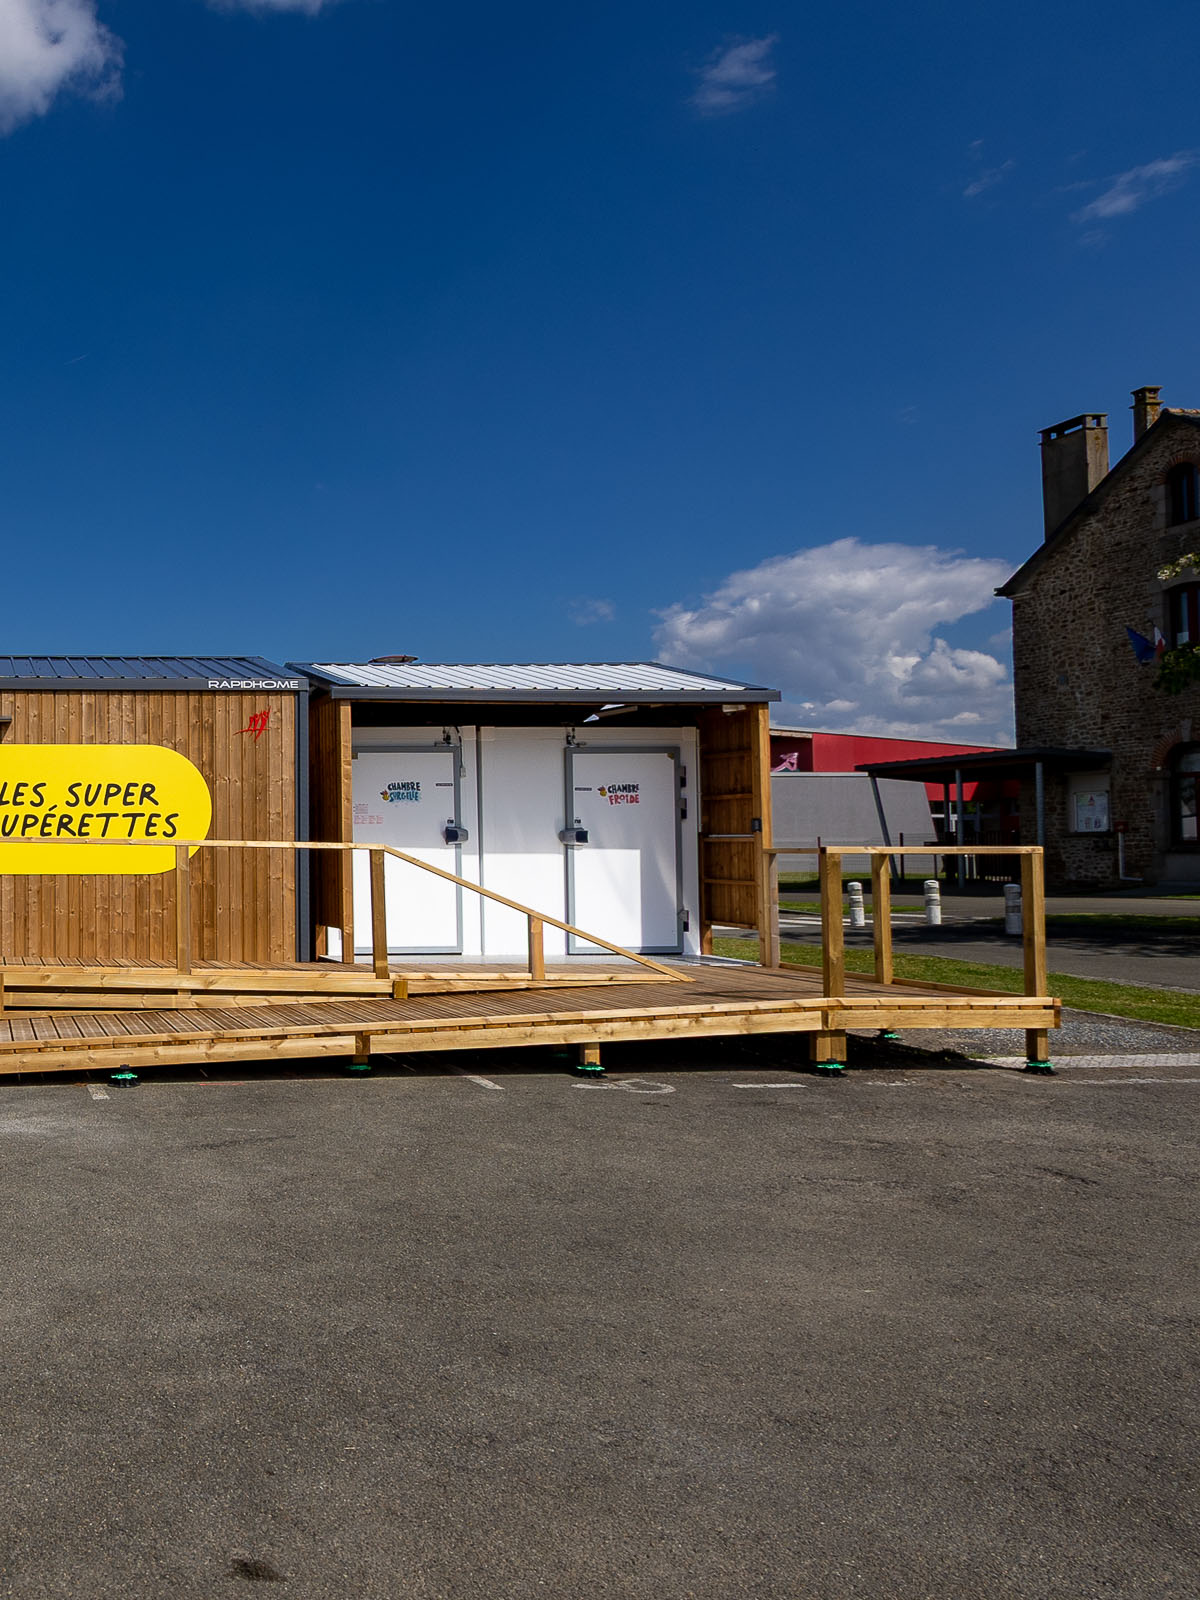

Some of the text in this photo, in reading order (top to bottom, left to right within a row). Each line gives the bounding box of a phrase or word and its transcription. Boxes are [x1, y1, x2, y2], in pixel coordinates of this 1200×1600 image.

[208, 680, 299, 689] RAPIDHOME
[387, 781, 421, 791] CHAMBRE
[607, 784, 640, 793] CHAMBRE
[65, 782, 159, 807] SUPER
[608, 794, 640, 805] FROIDE
